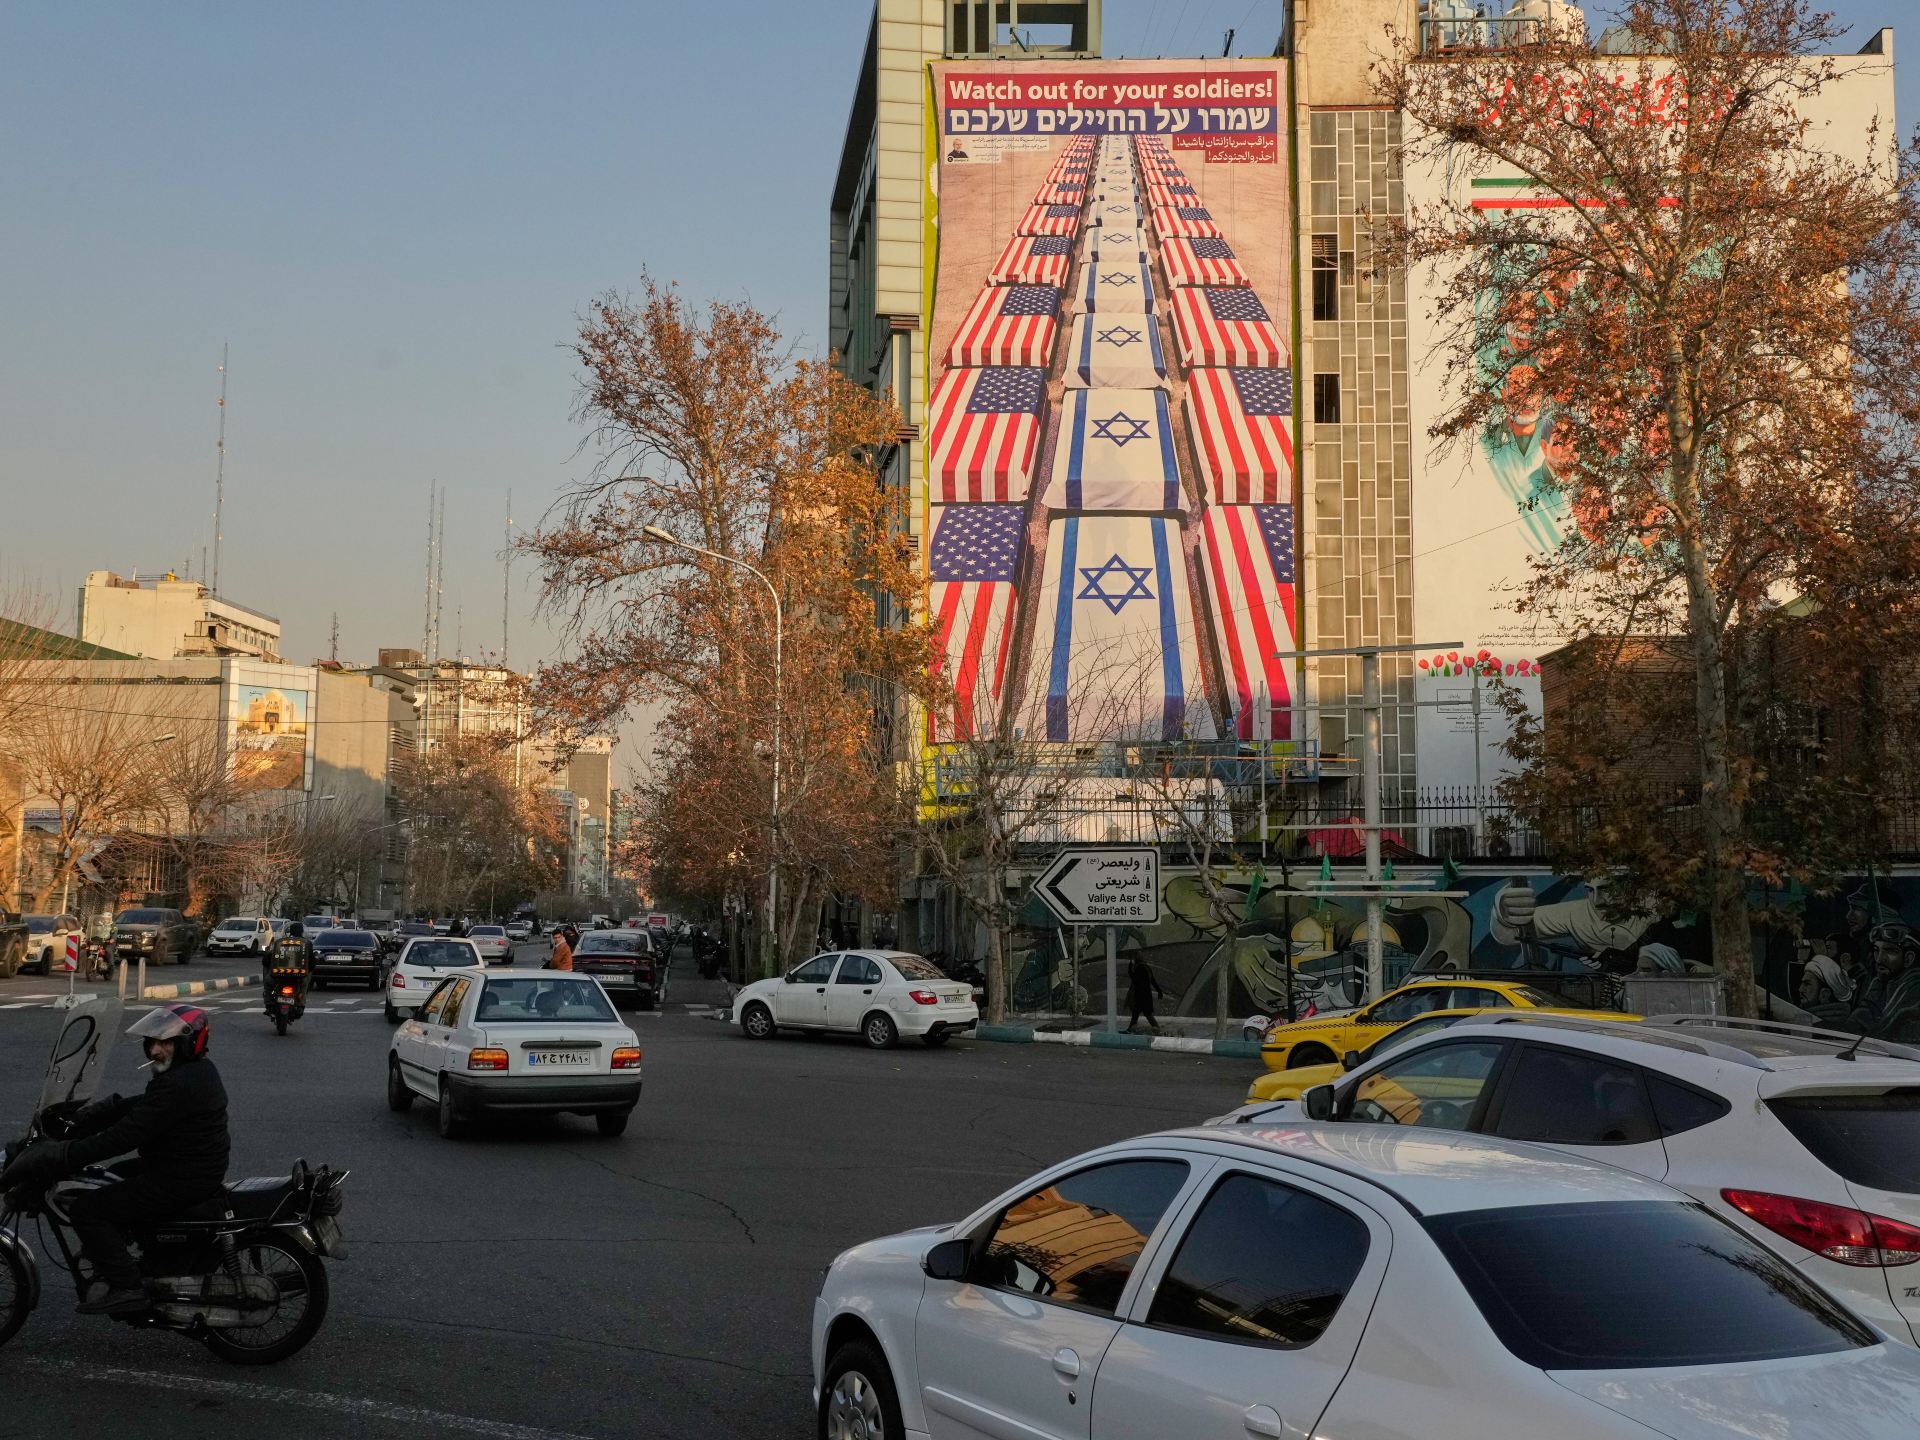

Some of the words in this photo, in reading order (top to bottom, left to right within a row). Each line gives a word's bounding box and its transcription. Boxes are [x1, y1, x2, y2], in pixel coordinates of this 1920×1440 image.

[949, 79, 1022, 100] Watch
[1027, 82, 1068, 100] out
[1073, 79, 1108, 100] for
[1112, 83, 1168, 105] your
[1172, 78, 1273, 99] soldiers!
[949, 101, 1029, 132] שלכם
[1036, 101, 1147, 132] החיילים
[1154, 101, 1191, 133] על
[1197, 106, 1271, 131] שמרו
[1176, 135, 1205, 149] باشید!
[1205, 135, 1247, 149] سربازانتان
[1247, 135, 1274, 149] مراقب
[1098, 857, 1140, 871] ولیعصر
[1095, 875, 1140, 890] شریعتی
[1087, 893, 1117, 904] Valiye
[1119, 894, 1137, 903] Asr
[1138, 893, 1153, 903] St.
[1087, 905, 1127, 916] Shari'ati
[1129, 906, 1143, 916] St.
